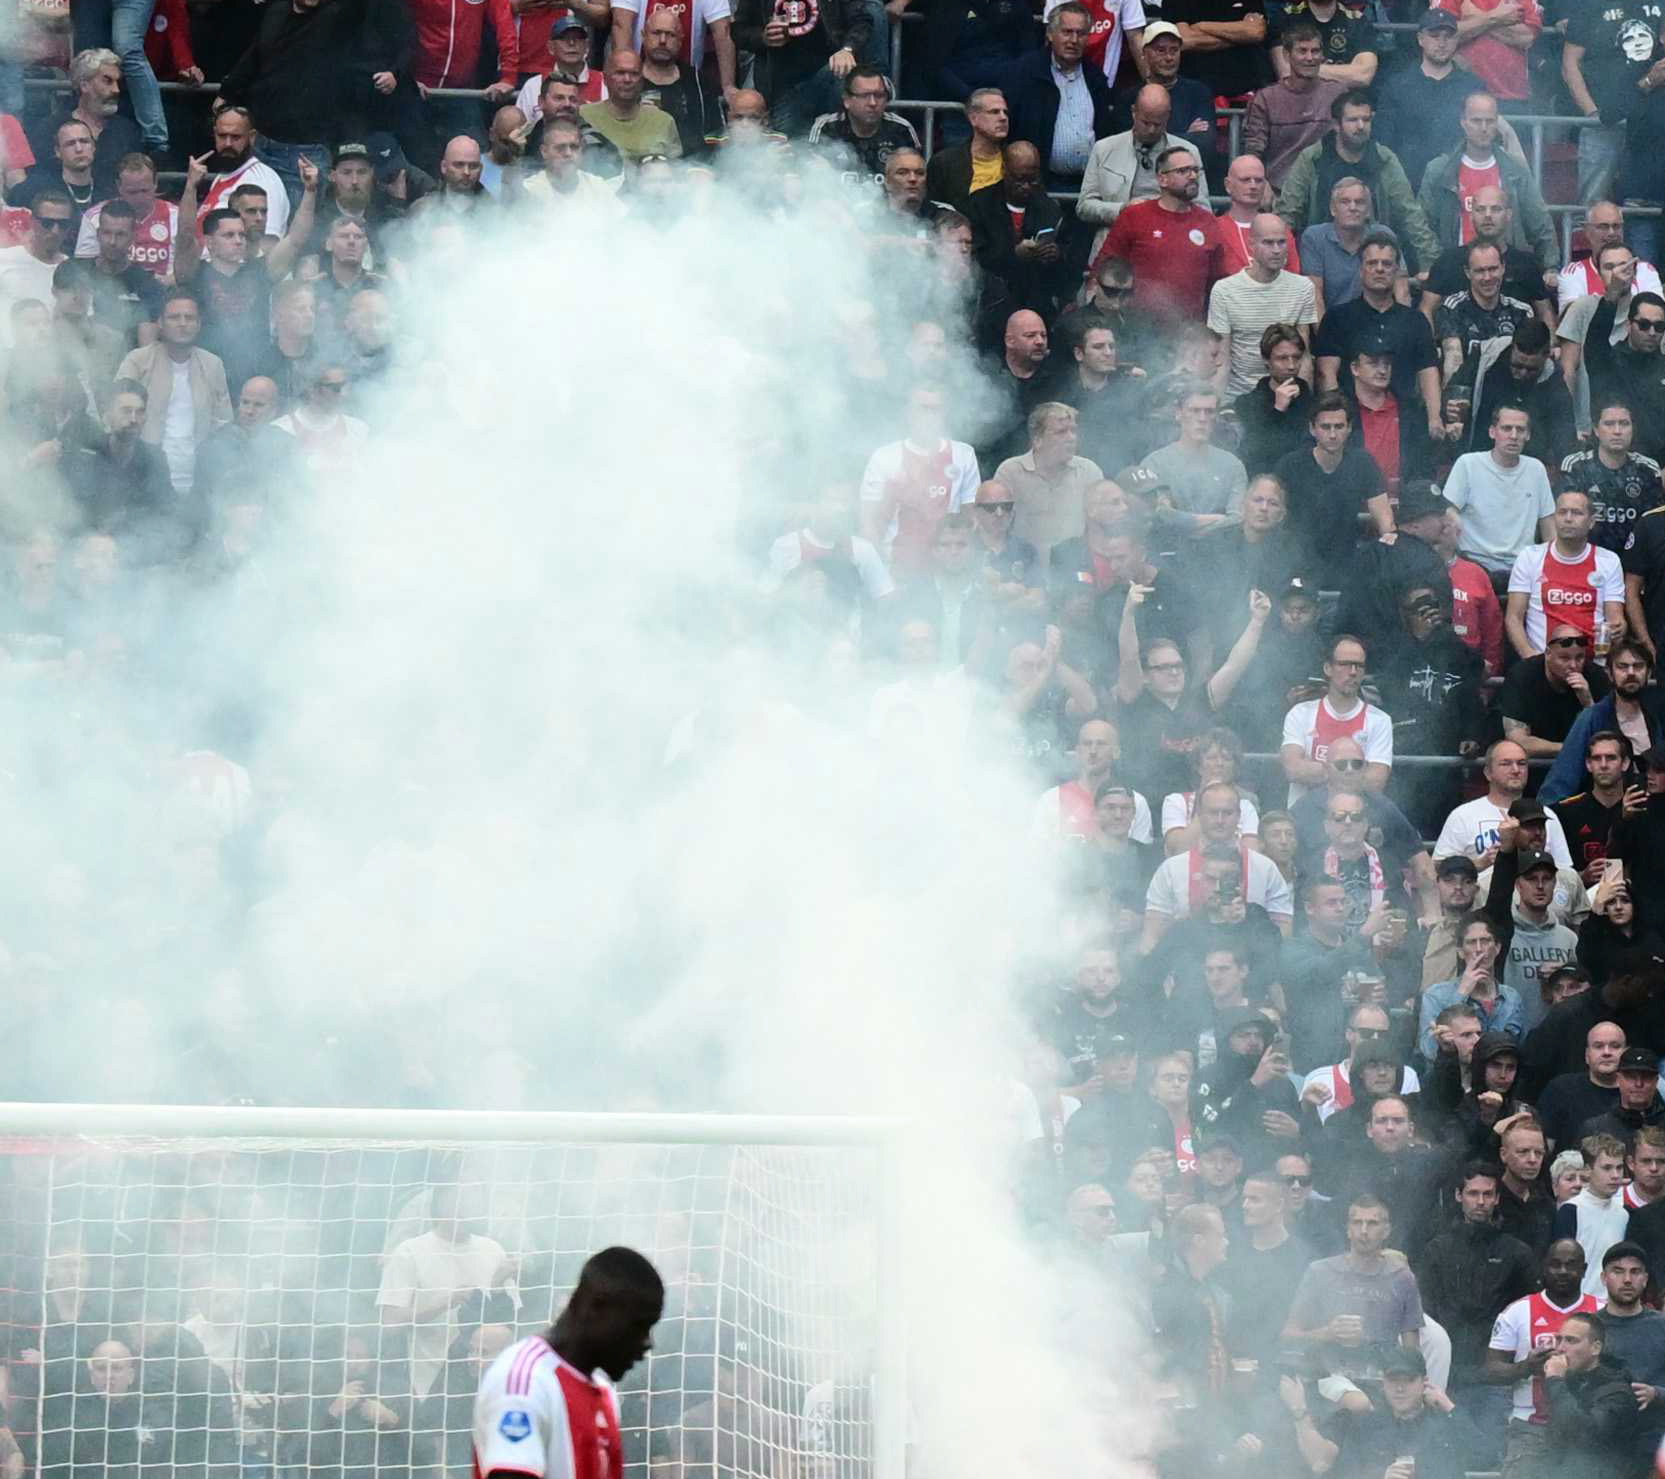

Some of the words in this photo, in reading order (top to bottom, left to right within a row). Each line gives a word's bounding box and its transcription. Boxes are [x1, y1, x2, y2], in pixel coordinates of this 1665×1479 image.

[1641, 6, 1661, 17] 14
[128, 245, 168, 263] iggo
[1548, 588, 1593, 606] Ziggo
